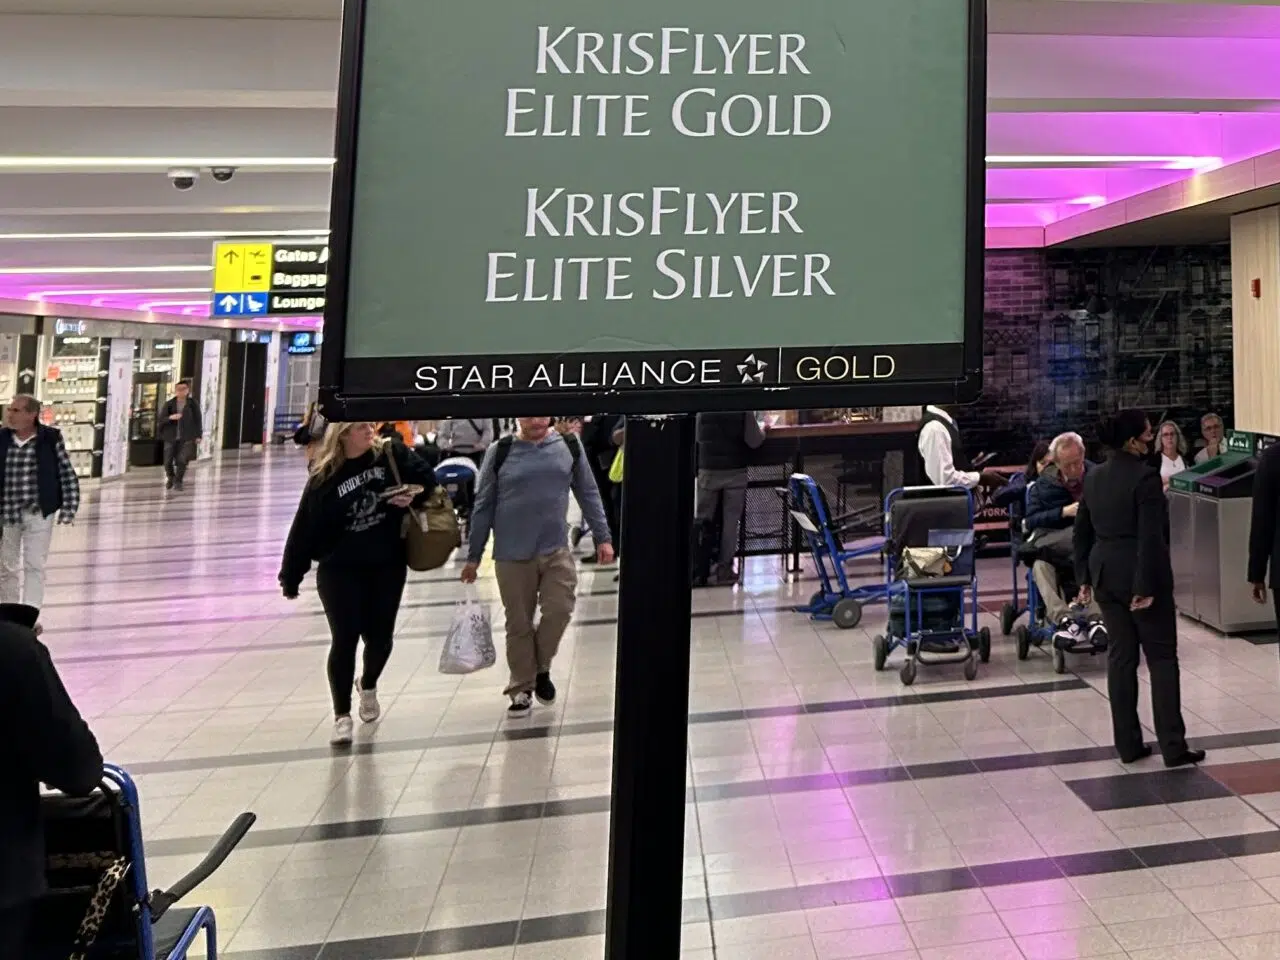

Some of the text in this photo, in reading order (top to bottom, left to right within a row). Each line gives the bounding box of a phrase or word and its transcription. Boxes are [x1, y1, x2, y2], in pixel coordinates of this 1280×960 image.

[504, 87, 832, 137] ELITE GOLD
[273, 272, 327, 287] Baggag
[485, 248, 836, 302] ELITE SILVER
[414, 354, 896, 392] STAR ALLIANCE GOLD
